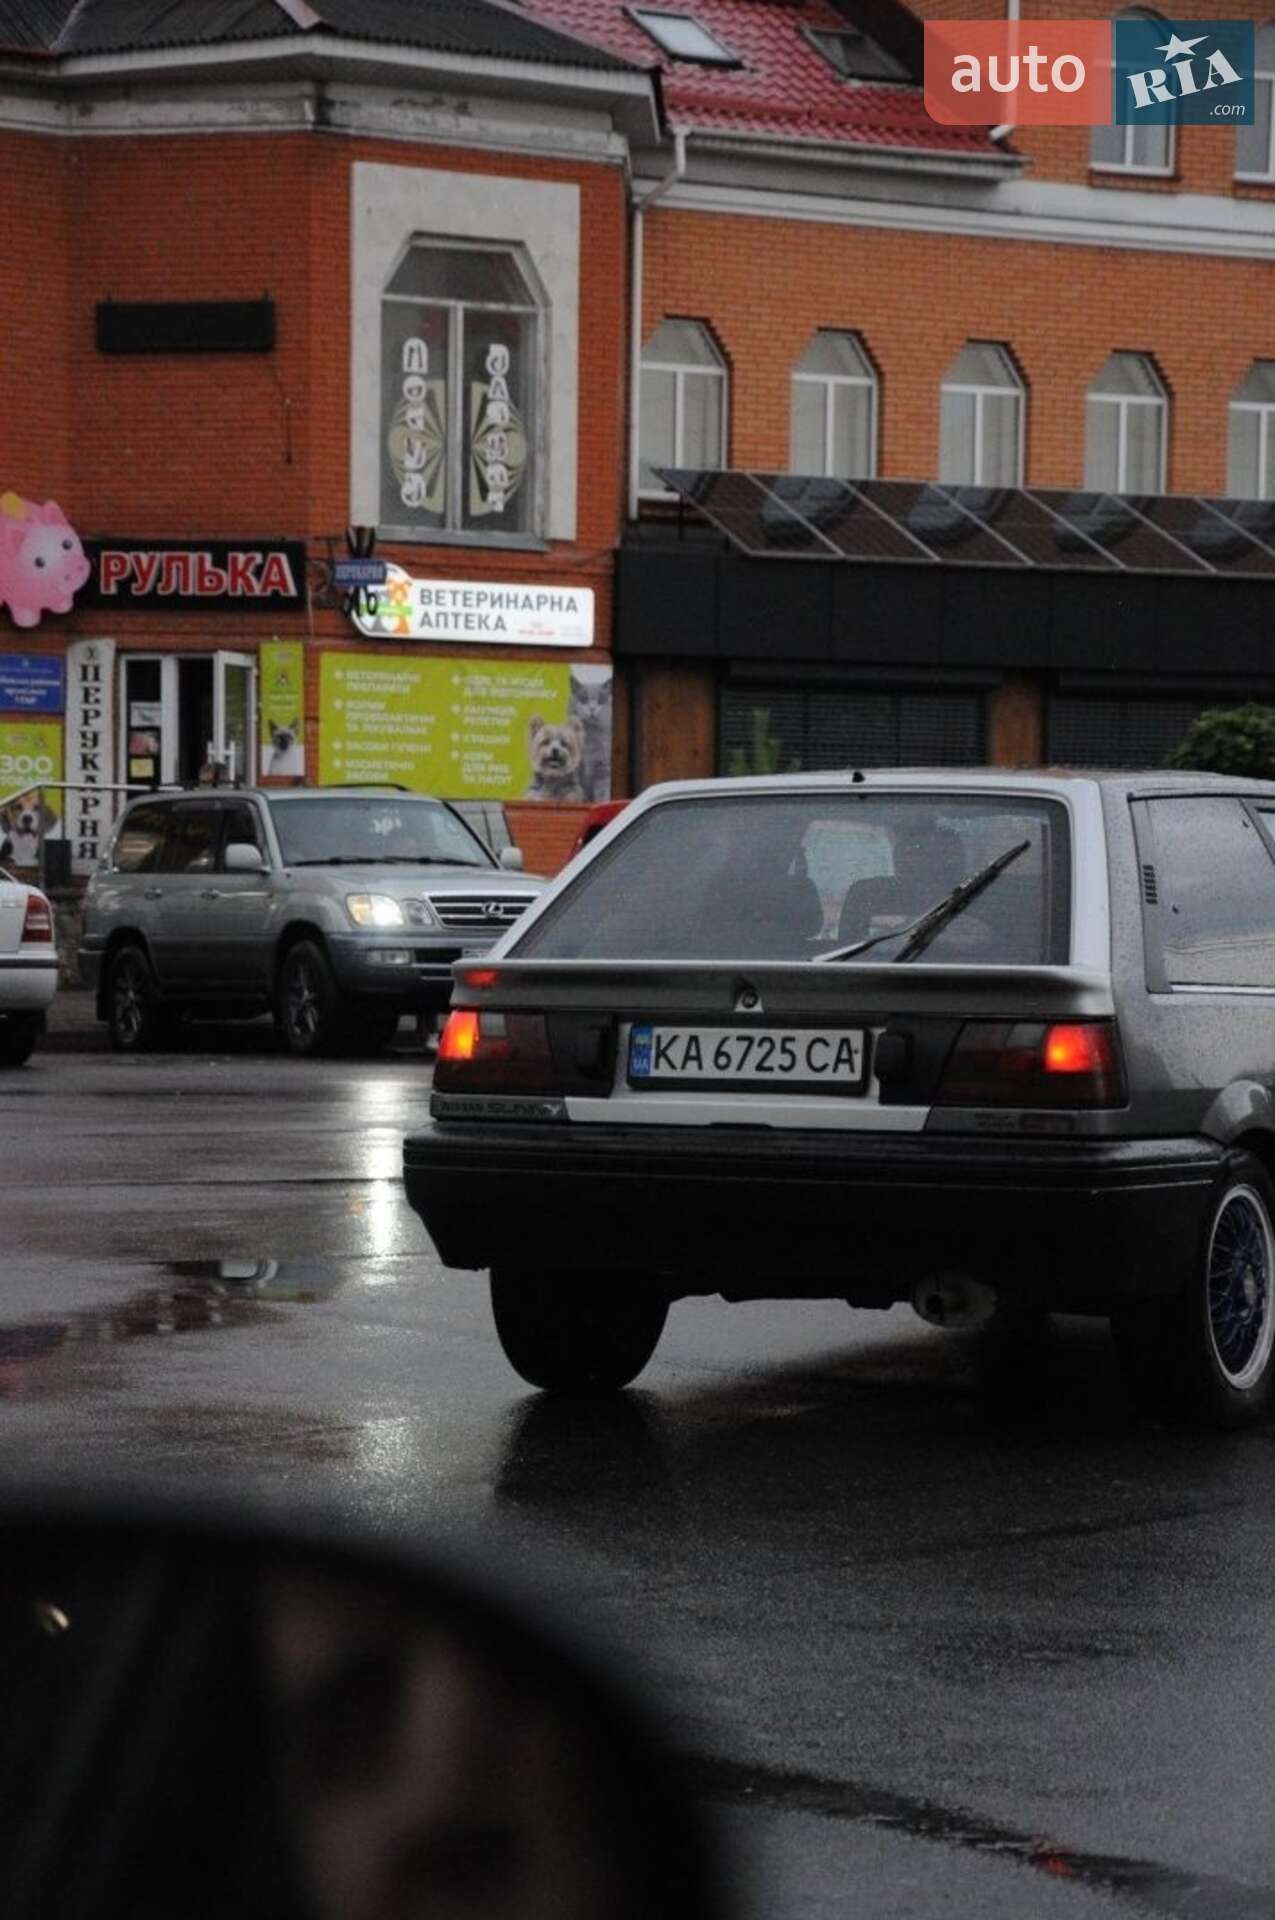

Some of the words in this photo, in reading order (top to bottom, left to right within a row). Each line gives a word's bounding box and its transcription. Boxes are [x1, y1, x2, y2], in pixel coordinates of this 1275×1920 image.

[100, 551, 297, 597] РУЛЬКА
[419, 588, 579, 613] ВЕТЕРИНАРНА
[419, 611, 507, 632] АПТЕКА
[654, 1034, 703, 1071] KA
[713, 1036, 797, 1073] 6725
[805, 1037, 855, 1074] CA
